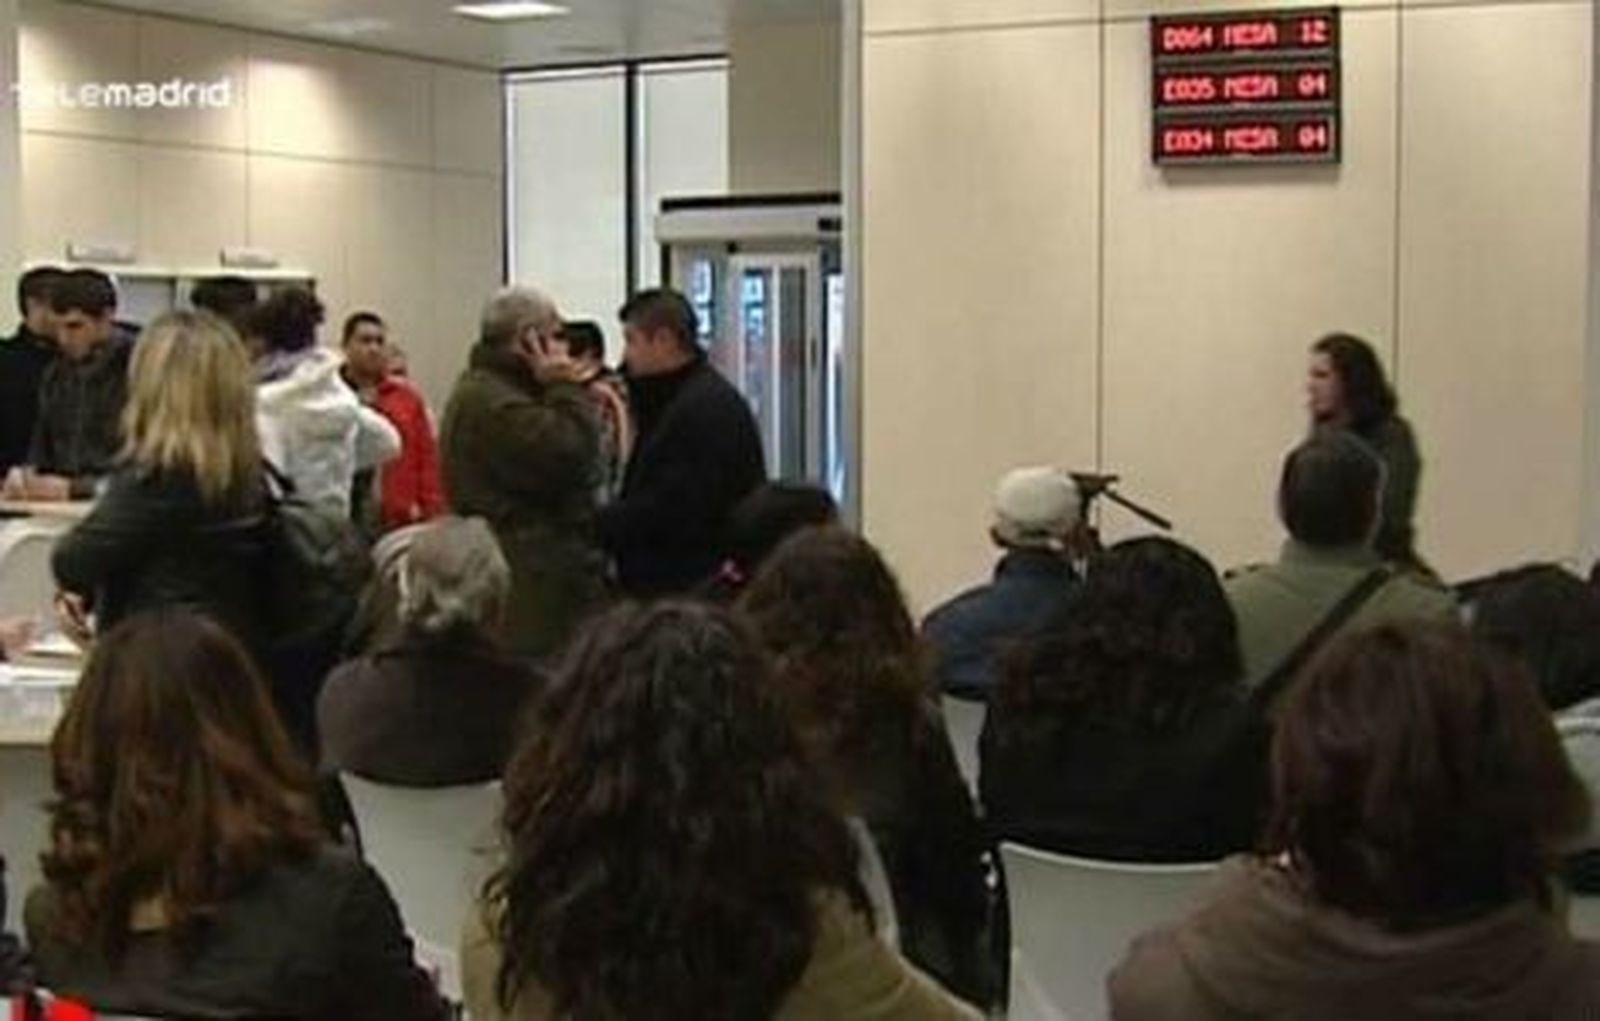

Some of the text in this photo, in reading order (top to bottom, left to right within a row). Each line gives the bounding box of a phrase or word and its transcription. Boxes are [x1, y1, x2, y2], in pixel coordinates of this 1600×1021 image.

[1301, 19, 1327, 43] 12
[1298, 72, 1326, 96] 04
[1298, 125, 1326, 148] 04
